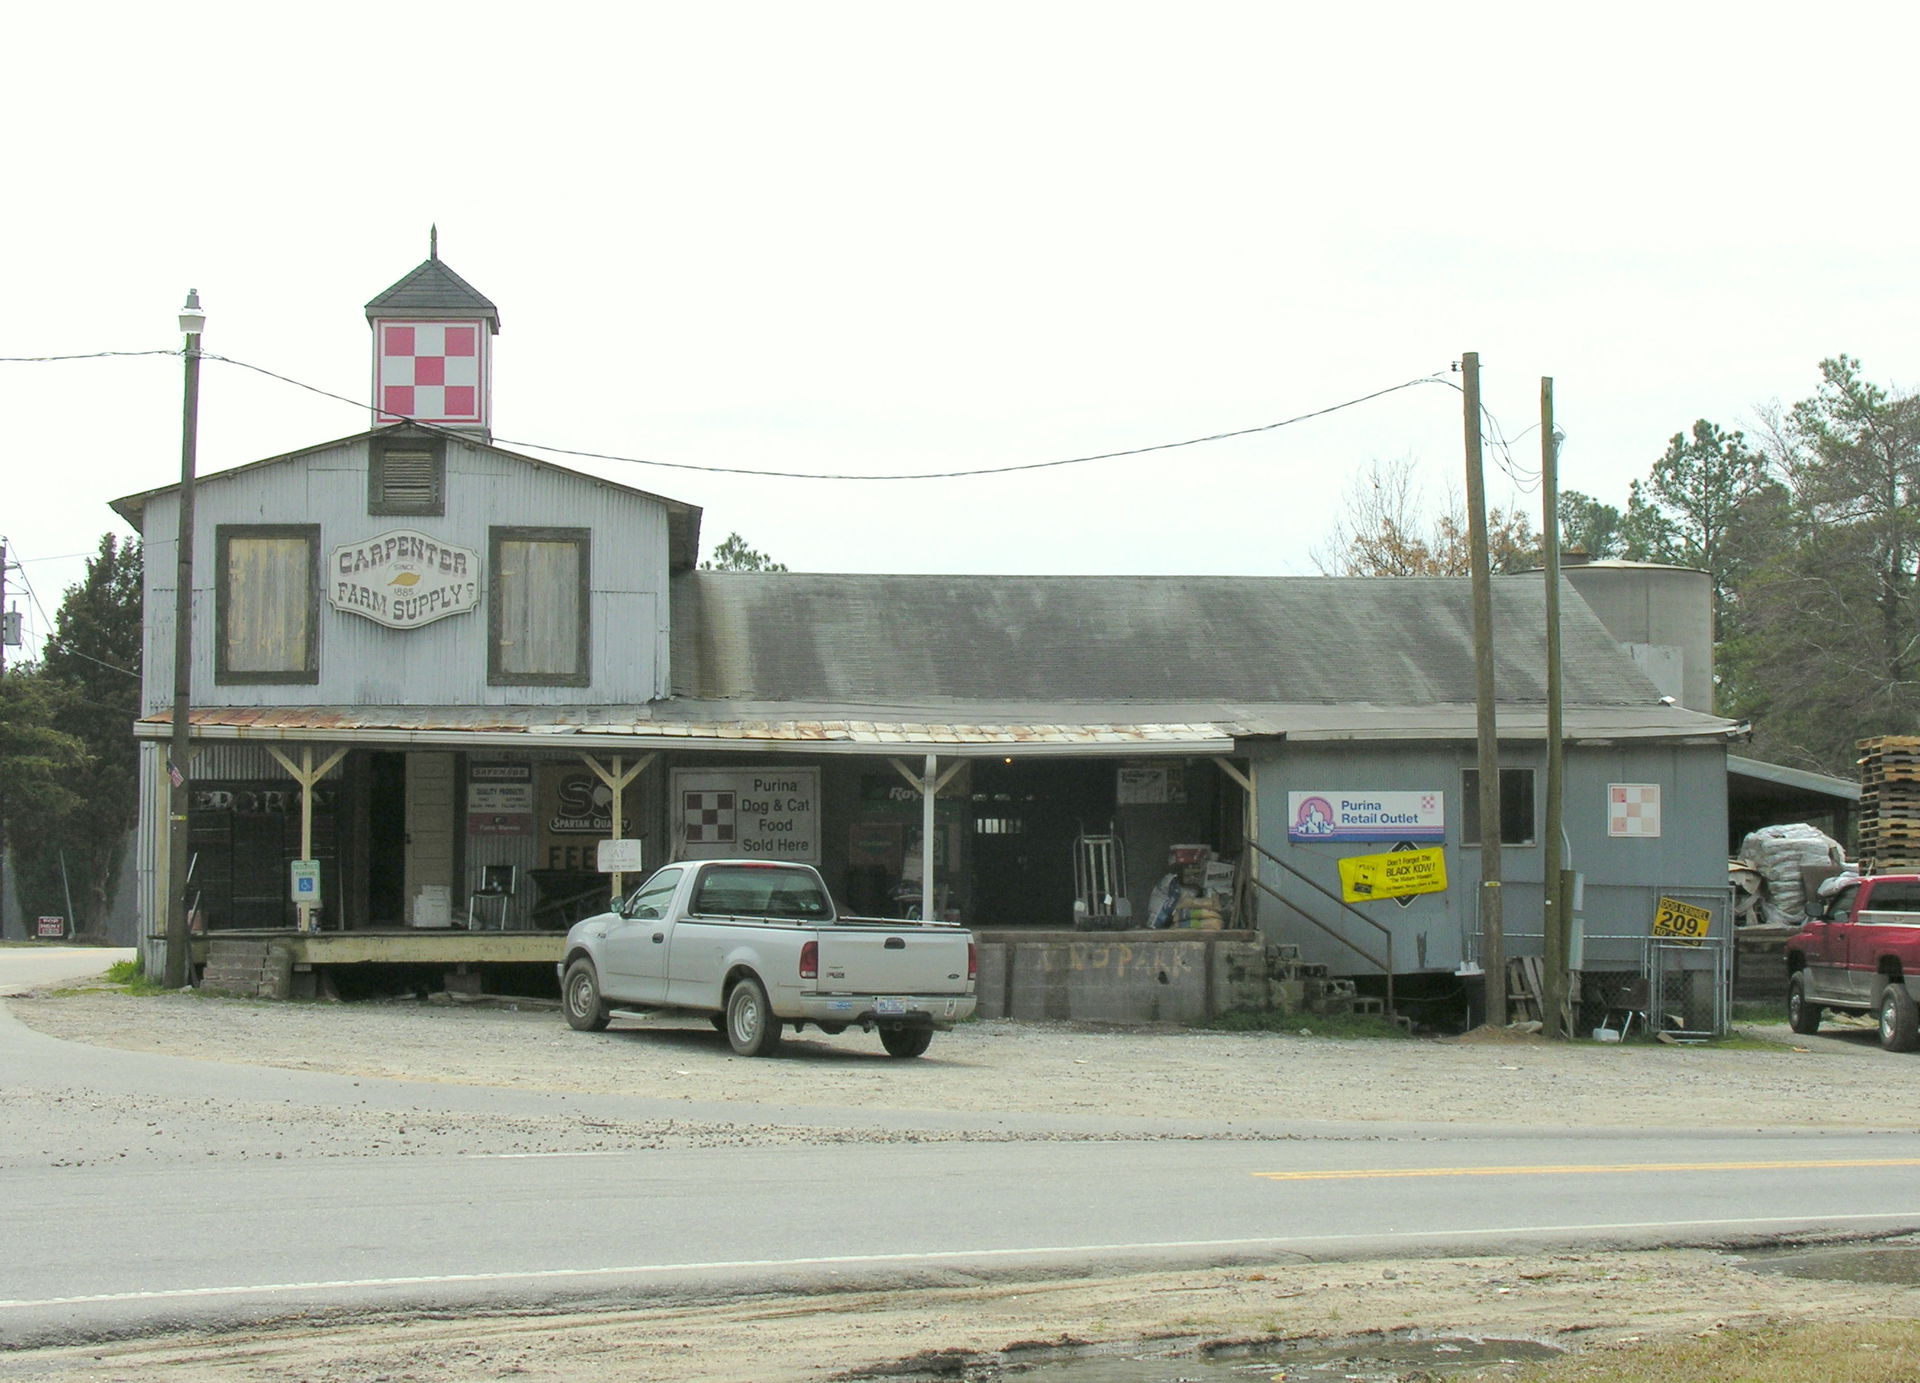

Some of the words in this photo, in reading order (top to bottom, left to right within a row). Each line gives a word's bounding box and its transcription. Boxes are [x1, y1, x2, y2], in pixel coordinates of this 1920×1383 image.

[339, 536, 467, 574] CARPENTER
[338, 582, 387, 616] FARM
[393, 584, 462, 620] SUPPLY
[754, 779, 797, 792] Purina
[742, 799, 769, 815] Dog
[773, 800, 783, 811] &
[787, 799, 810, 812] Cat
[1341, 800, 1382, 810] Purina
[553, 817, 590, 828] SPARTAN
[593, 818, 628, 828] QUAY
[1341, 813, 1378, 824] Retail
[1380, 813, 1419, 824] Outlet
[759, 819, 793, 832] Food
[743, 839, 773, 852] Sold
[778, 839, 809, 852] Here
[1386, 865, 1411, 877] BLACK
